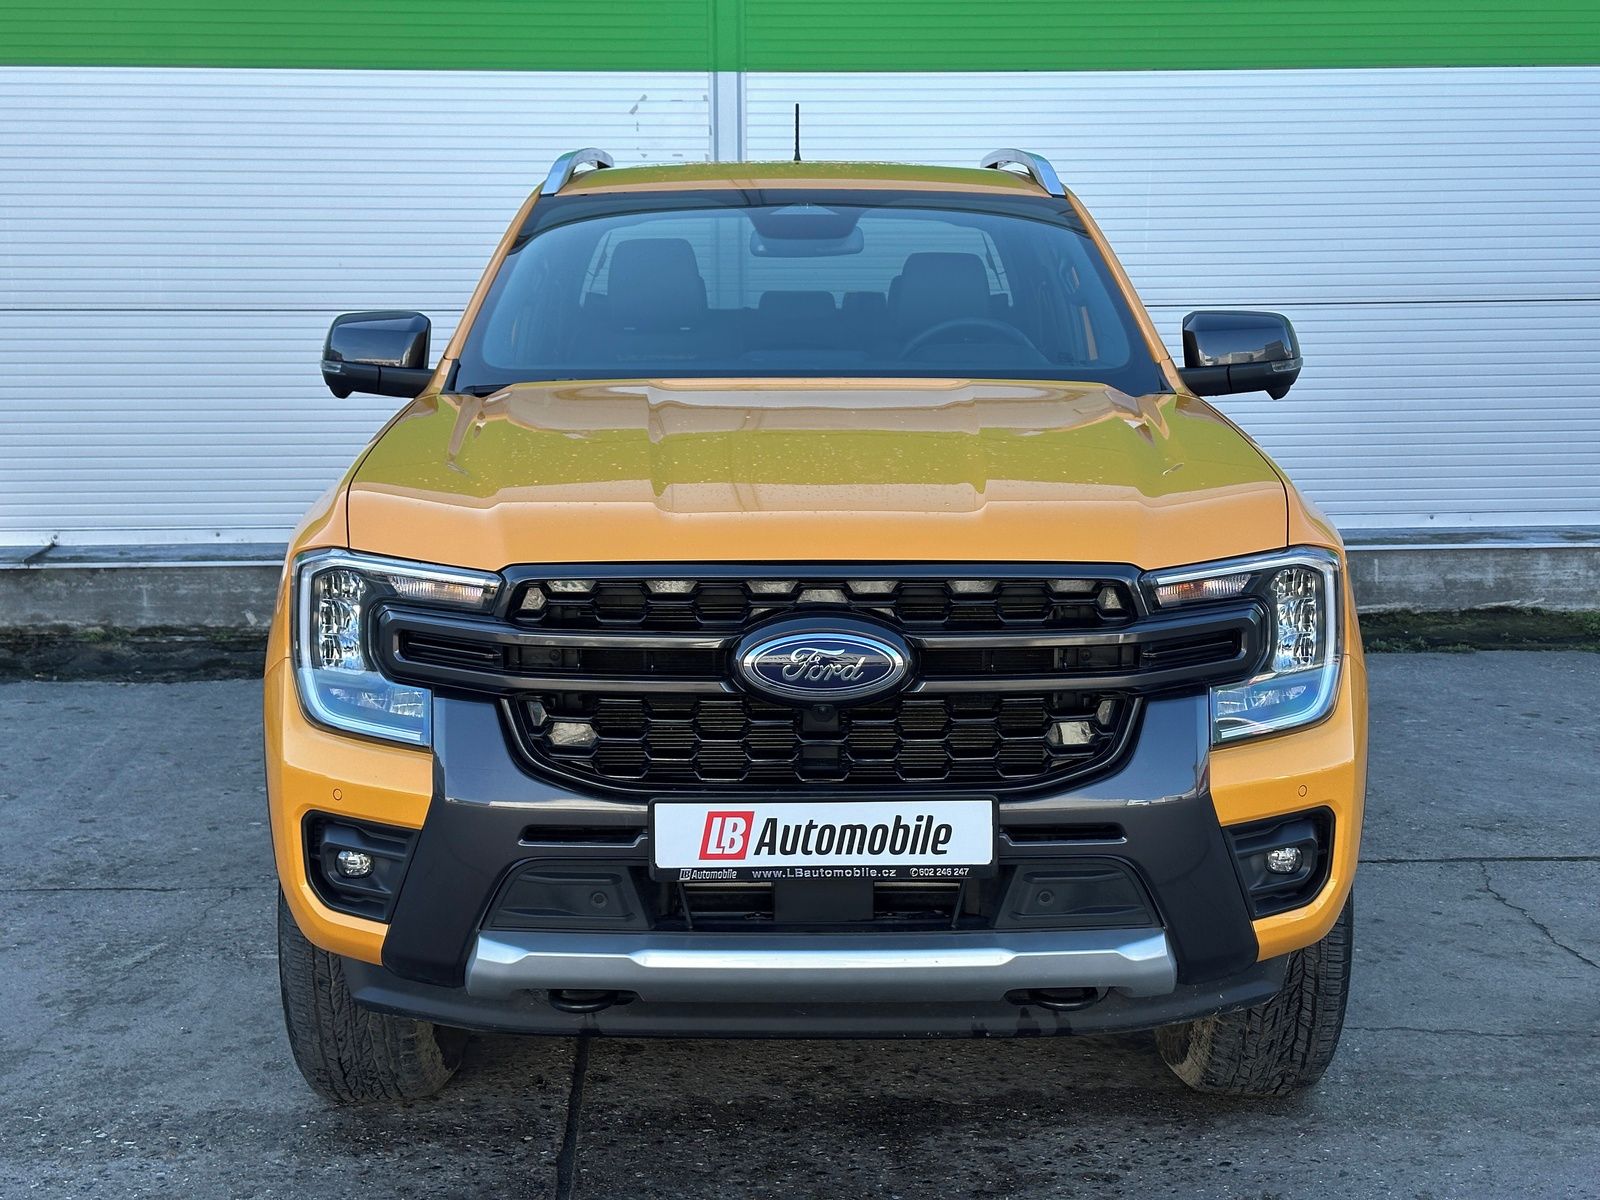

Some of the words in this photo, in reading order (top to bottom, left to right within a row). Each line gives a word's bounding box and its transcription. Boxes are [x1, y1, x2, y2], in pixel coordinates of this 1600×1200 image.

[782, 647, 866, 682] Ford
[704, 815, 747, 857] LB
[754, 815, 952, 856] Automobile
[692, 869, 737, 879] Automobile
[751, 867, 897, 878] www.LBautomobile.cz
[953, 867, 970, 876] 247
